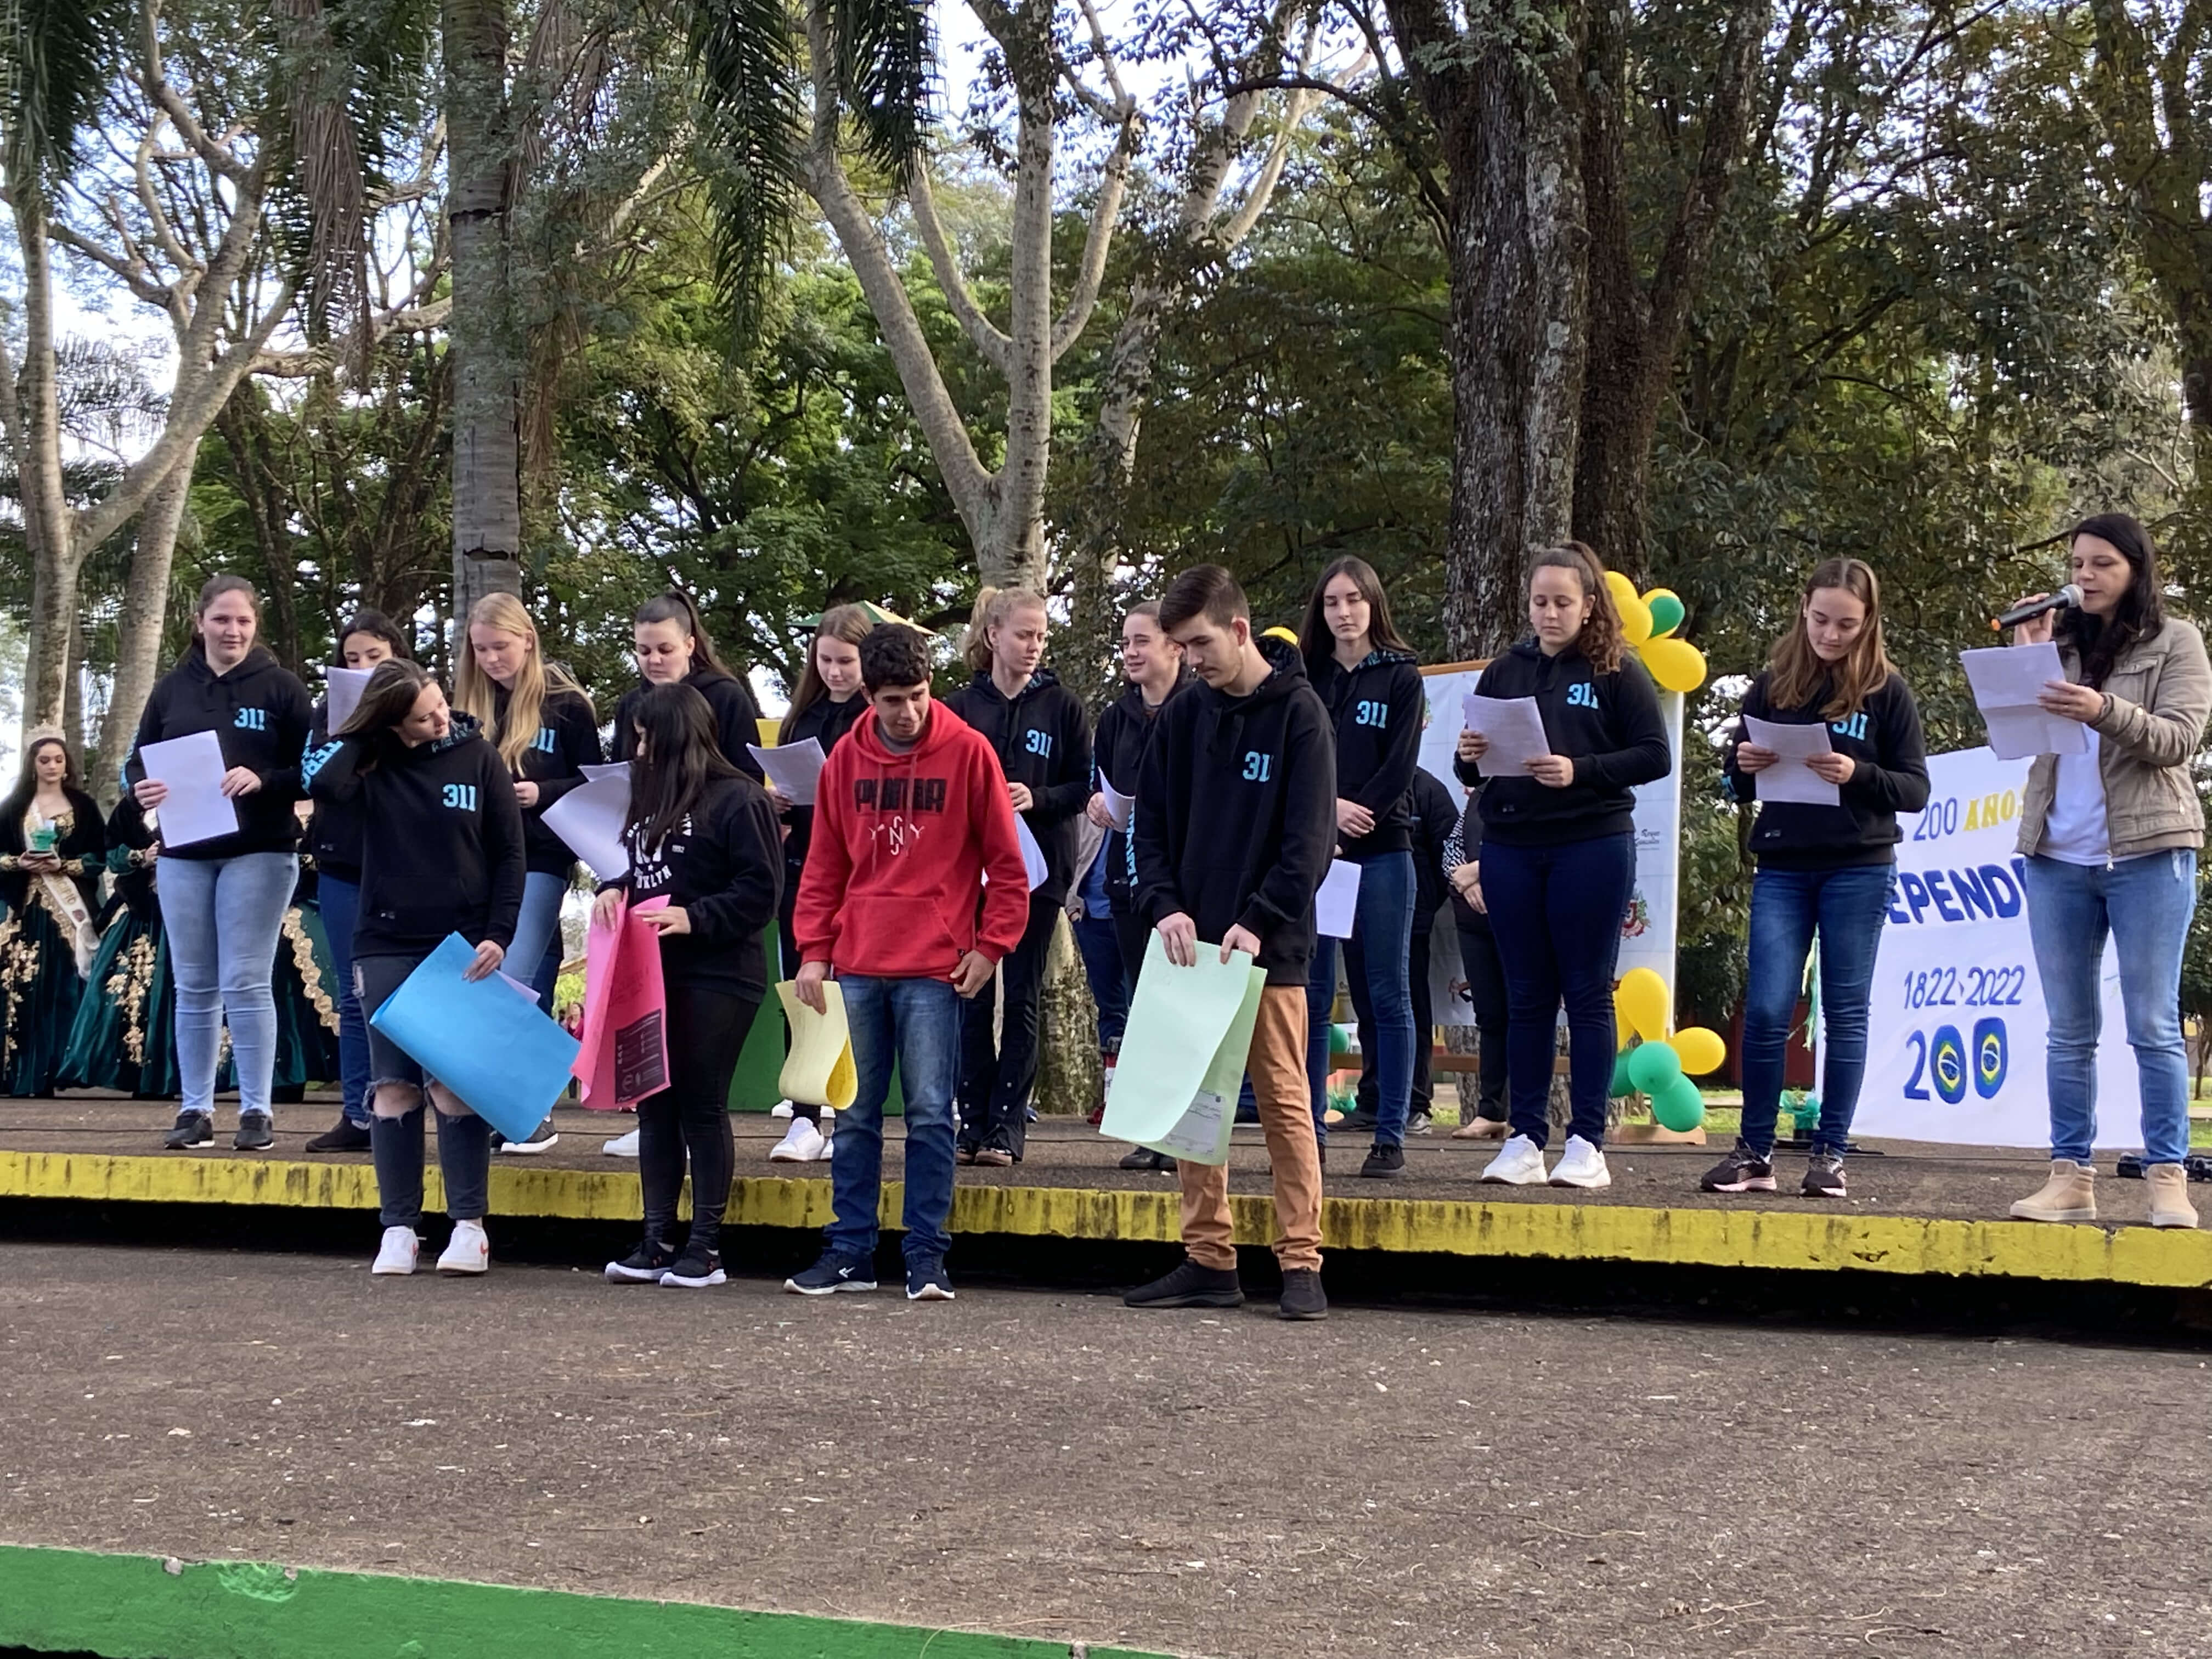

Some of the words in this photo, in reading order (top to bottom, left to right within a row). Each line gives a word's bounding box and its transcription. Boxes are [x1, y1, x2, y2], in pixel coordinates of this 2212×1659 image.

[234, 708, 265, 731] 311
[1356, 701, 1389, 729] 311
[443, 783, 476, 812] 311
[1913, 797, 1957, 841] 200
[1903, 1016, 2008, 1104] 200
